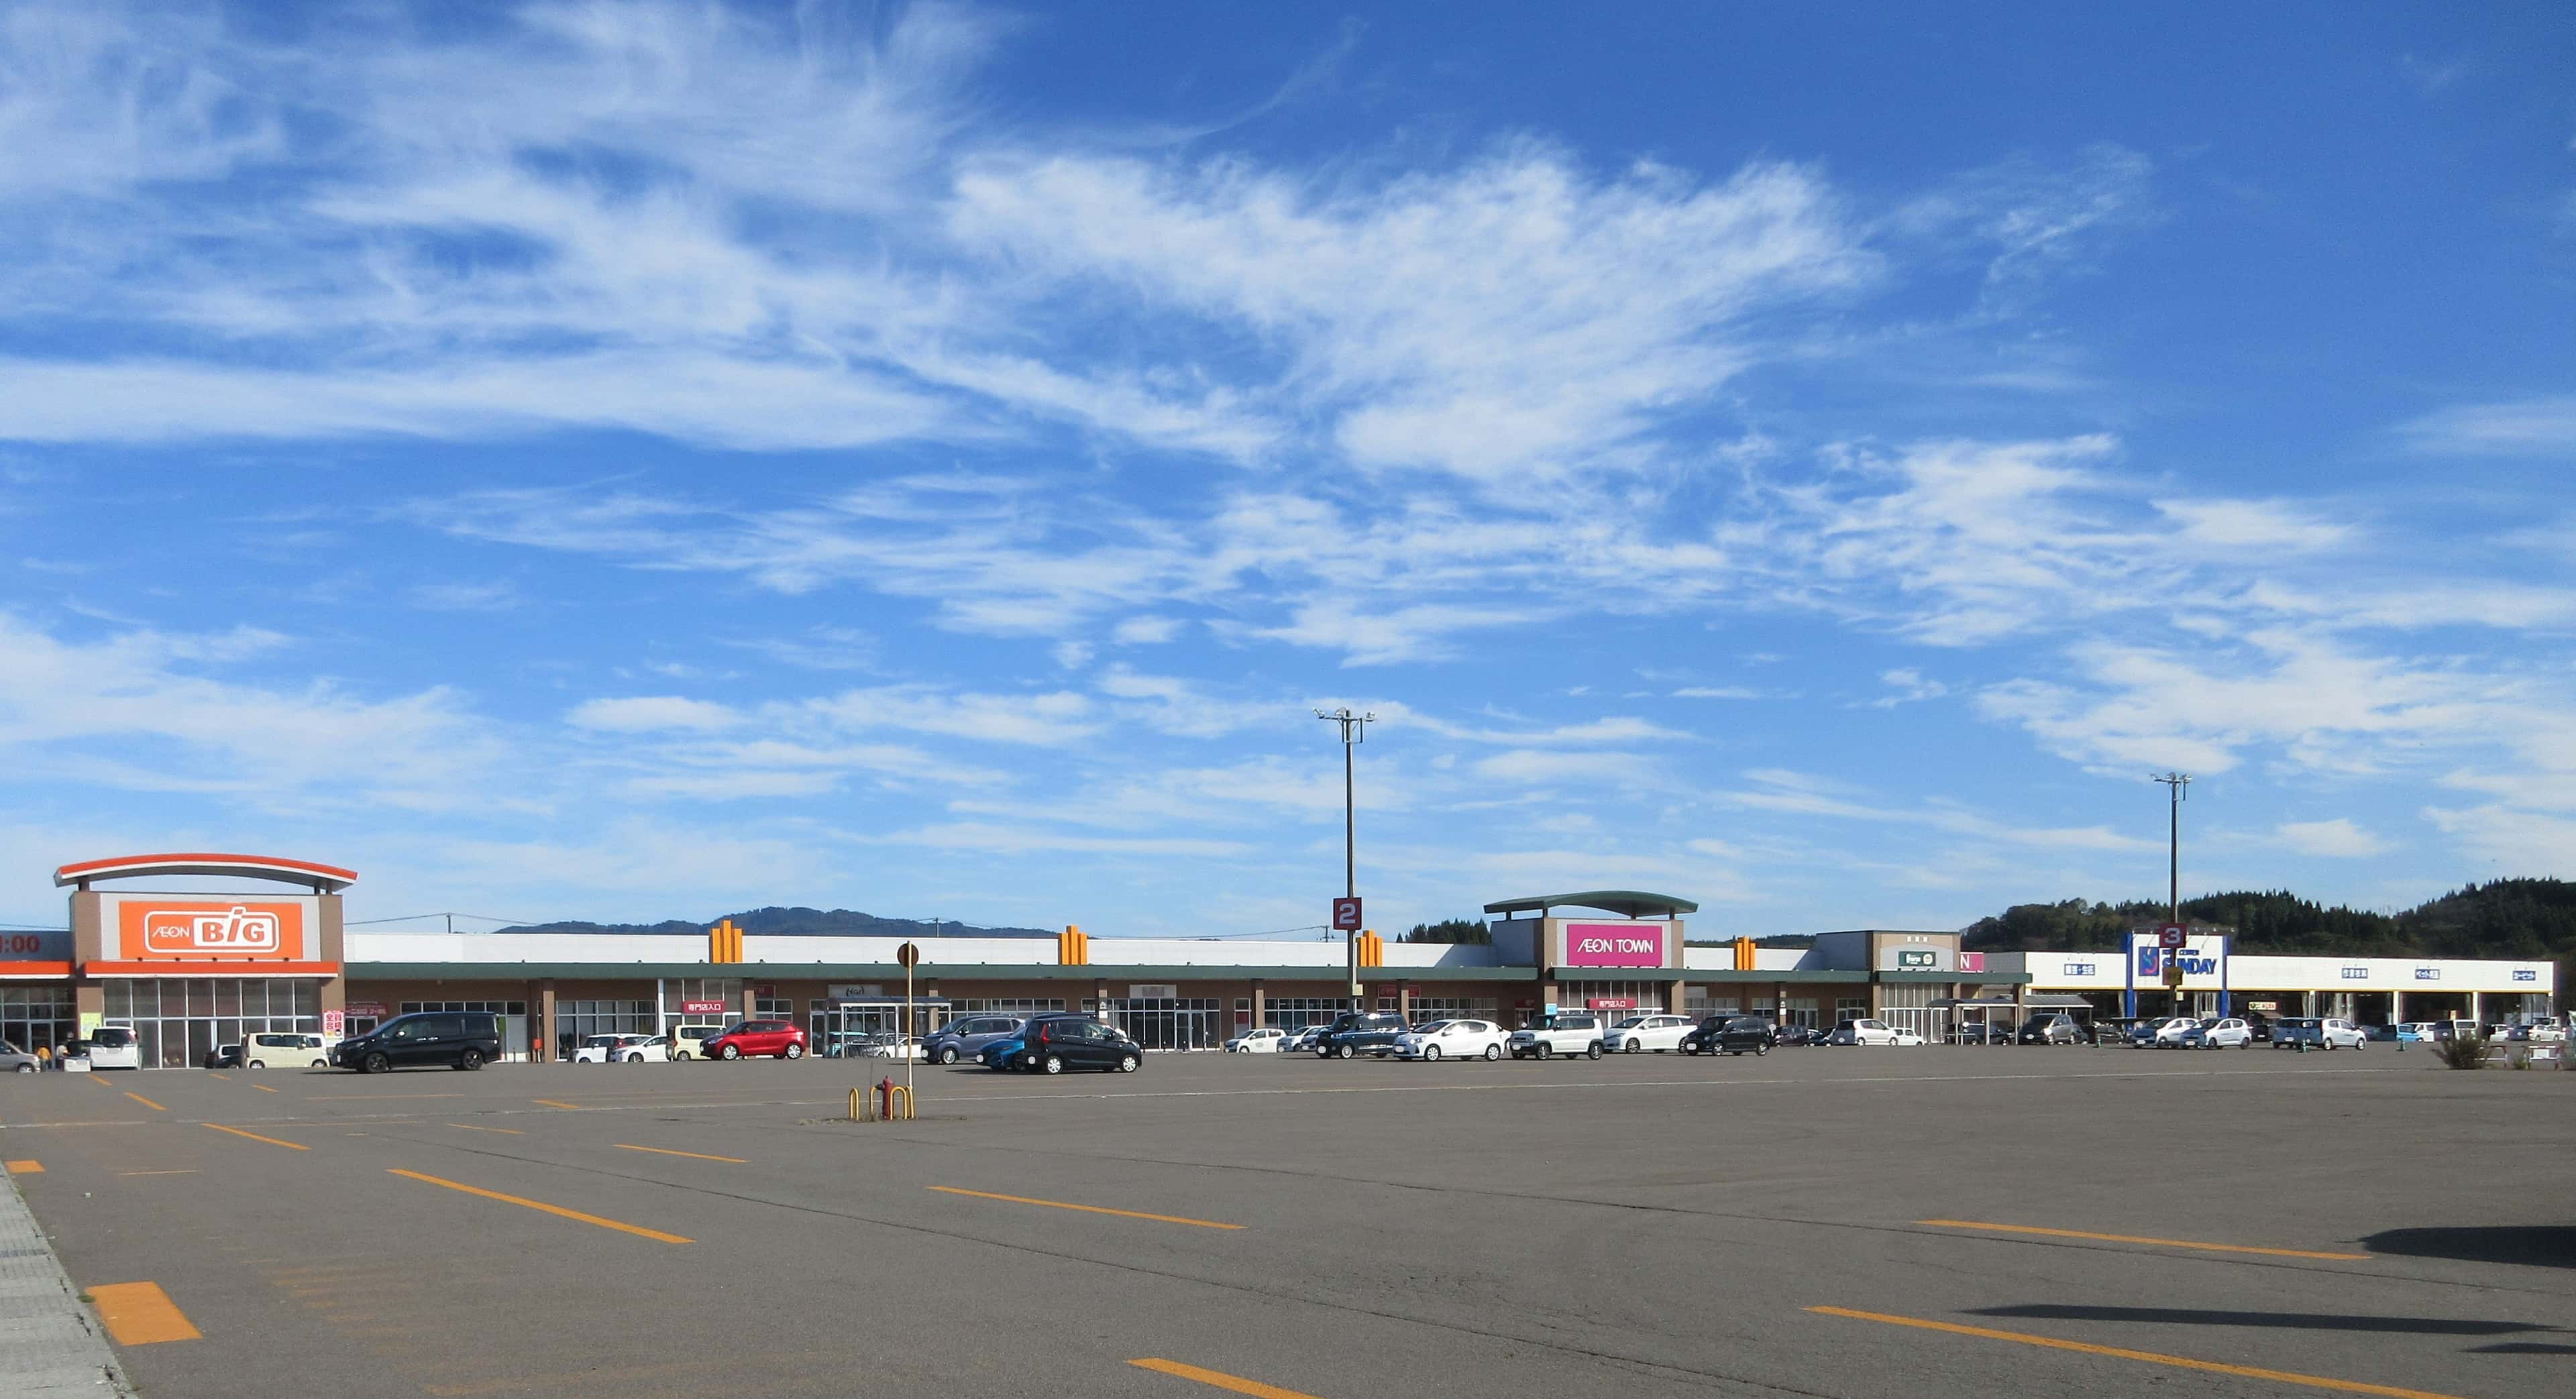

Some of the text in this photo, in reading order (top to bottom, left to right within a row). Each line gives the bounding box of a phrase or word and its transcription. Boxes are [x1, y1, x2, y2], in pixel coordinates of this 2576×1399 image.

[1339, 903, 1356, 924] 2
[0, 933, 40, 953] :00
[2164, 928, 2181, 944] 3
[1615, 938, 1653, 953] TOWN
[688, 1003, 721, 1011] 専門店入口
